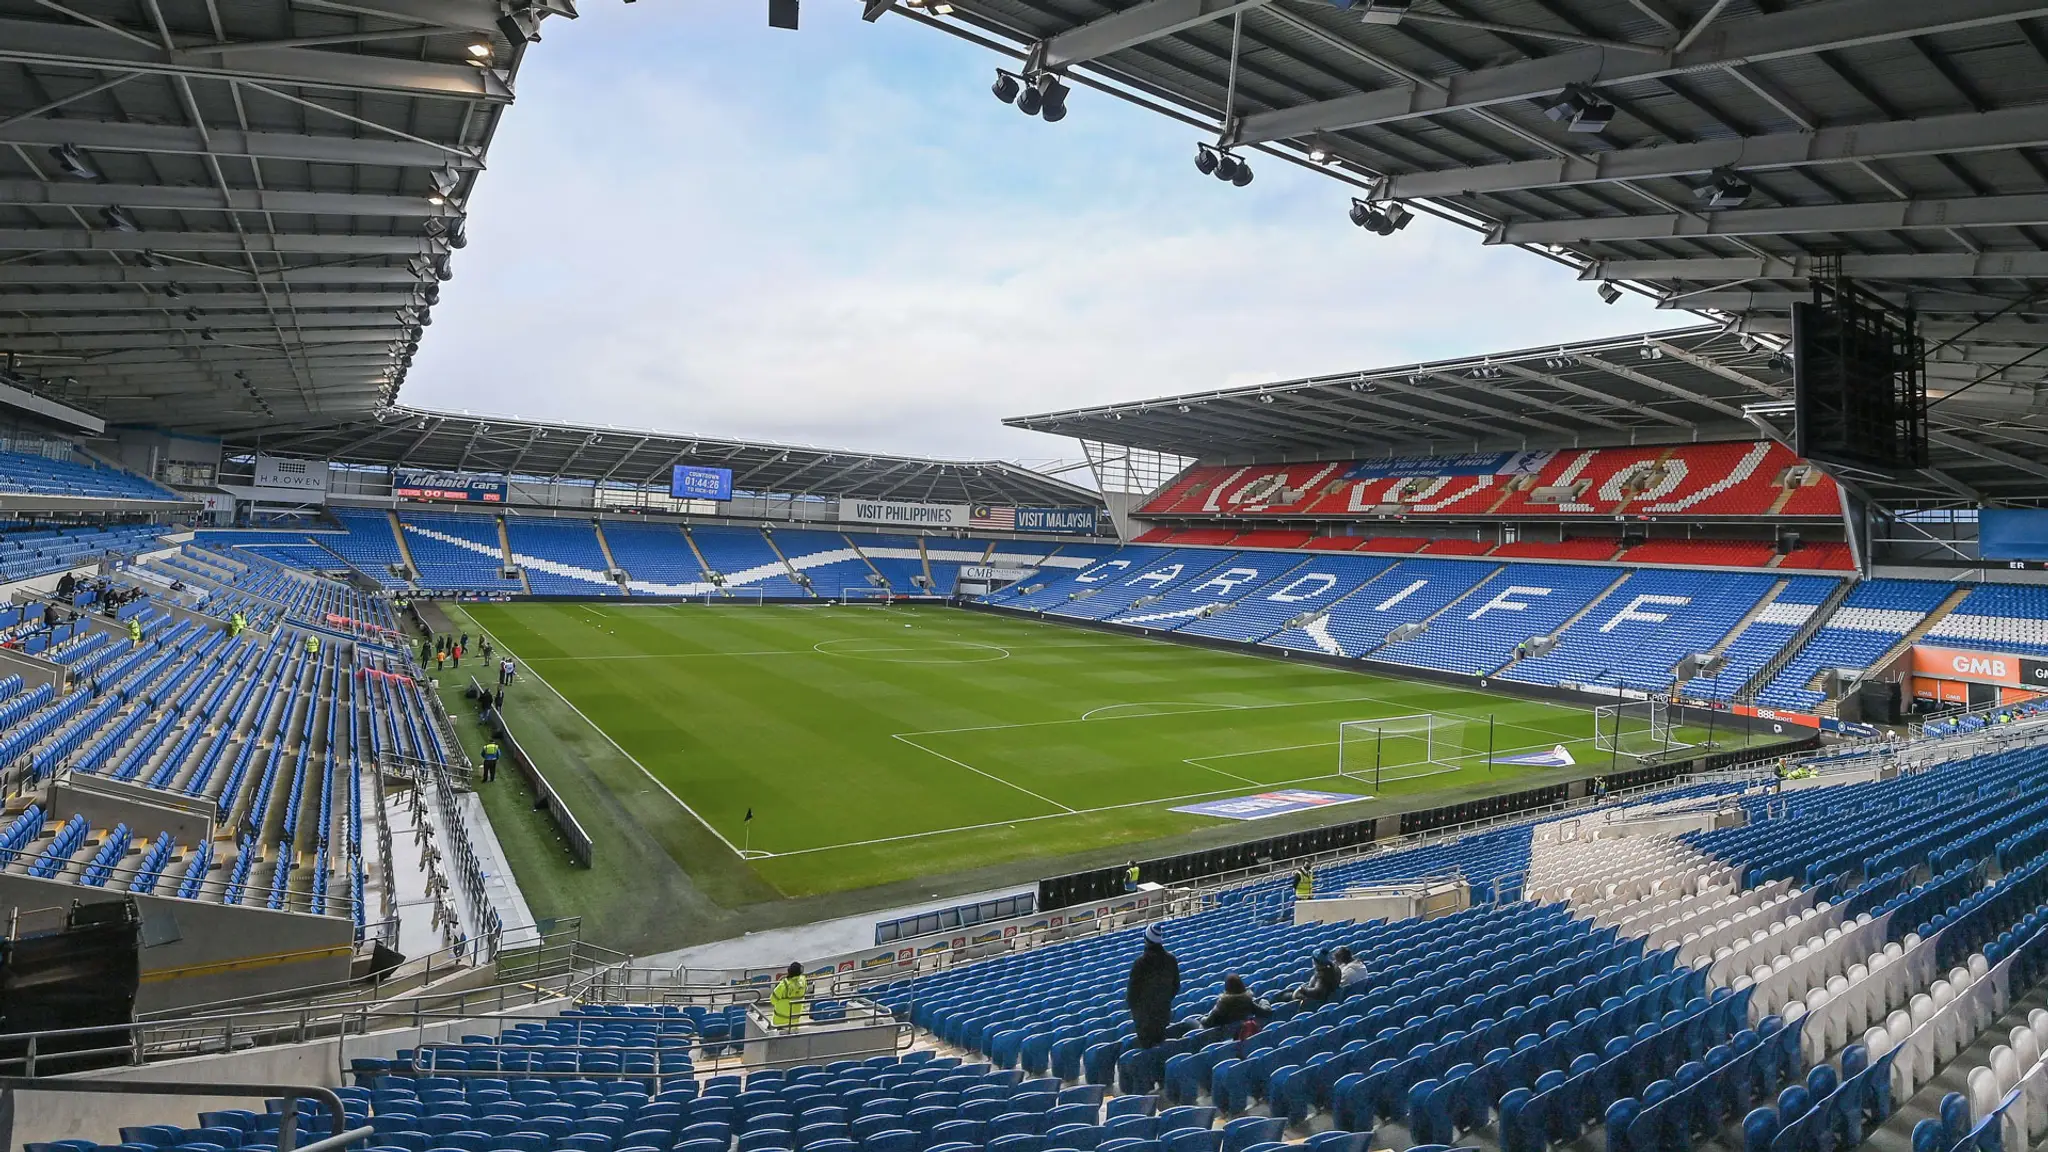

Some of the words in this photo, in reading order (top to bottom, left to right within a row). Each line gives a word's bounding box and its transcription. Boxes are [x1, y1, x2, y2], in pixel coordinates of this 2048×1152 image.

[1360, 461, 1391, 470] THAN
[1393, 461, 1416, 469] YOU
[1419, 459, 1449, 468] WILL
[1454, 457, 1497, 466] KNOW
[403, 473, 472, 489] Nathaniel
[472, 481, 499, 490] cars
[685, 477, 719, 489] 01:44:26
[856, 503, 883, 519] VISIT
[885, 506, 952, 523] PHILIPPINES
[1018, 512, 1044, 527] VISIT
[1046, 513, 1093, 528] MALAYSIA
[967, 567, 993, 578] CMB
[1075, 559, 1692, 633] CARDIFF
[1952, 655, 2007, 677] GMB
